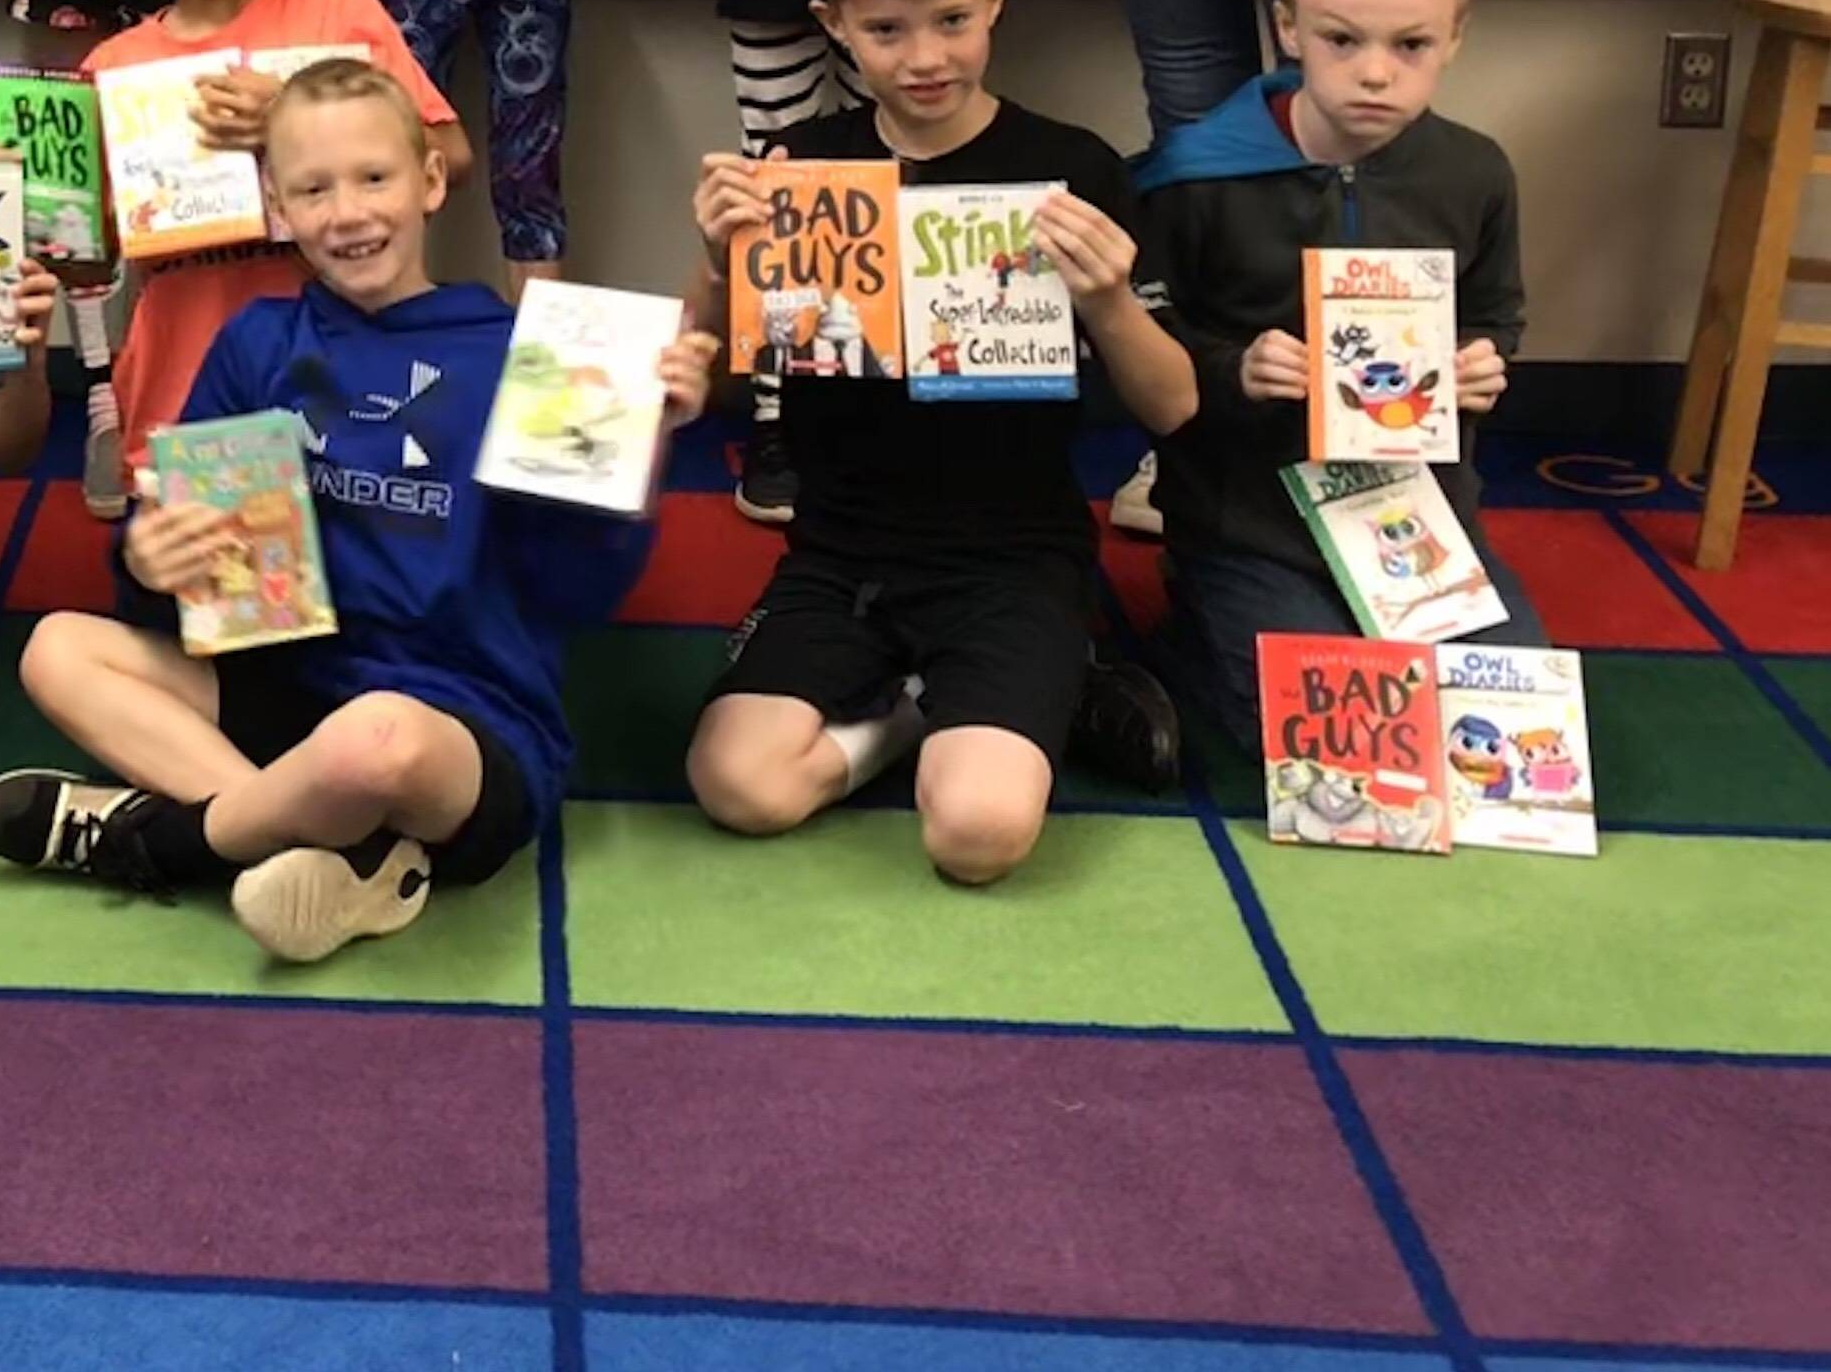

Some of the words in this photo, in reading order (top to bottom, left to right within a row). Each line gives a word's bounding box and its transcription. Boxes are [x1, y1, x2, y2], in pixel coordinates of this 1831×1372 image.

[12, 94, 84, 142] BAD
[769, 185, 882, 240] BAD
[745, 234, 887, 297] GUYS
[1345, 258, 1398, 280] OWL
[968, 338, 1072, 366] Collection
[1463, 652, 1519, 675] OWL
[1300, 665, 1412, 719] BAD
[1281, 713, 1420, 769] GUYS
